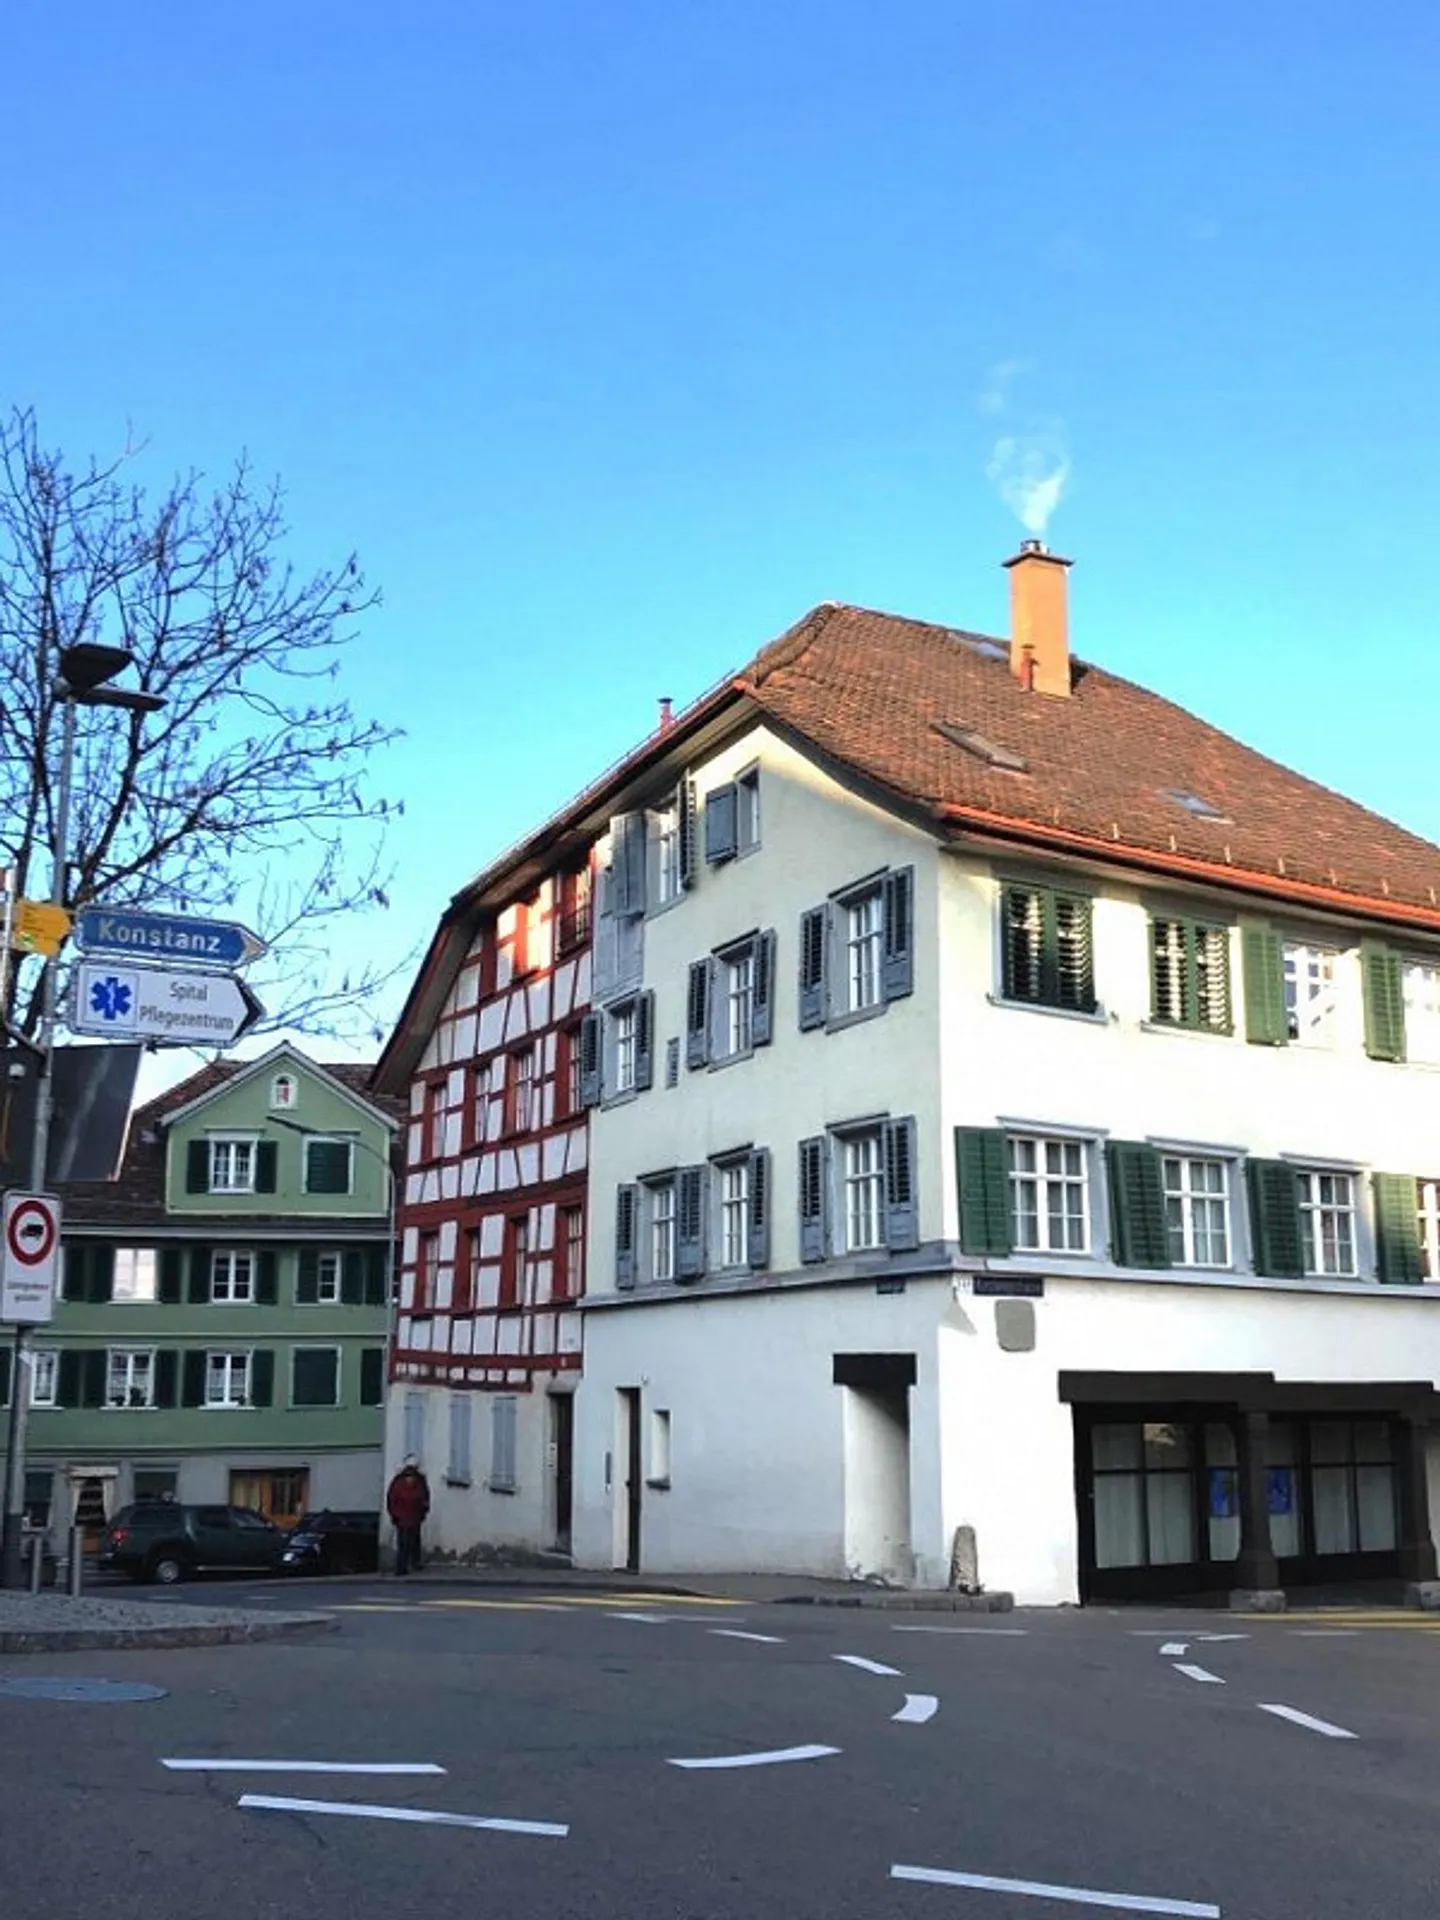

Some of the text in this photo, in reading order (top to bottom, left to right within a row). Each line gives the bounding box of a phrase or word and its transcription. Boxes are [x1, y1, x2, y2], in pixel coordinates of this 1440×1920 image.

[99, 917, 221, 952] Konstanz
[169, 981, 208, 1002] Spital
[140, 1004, 234, 1030] Pflegezentrum
